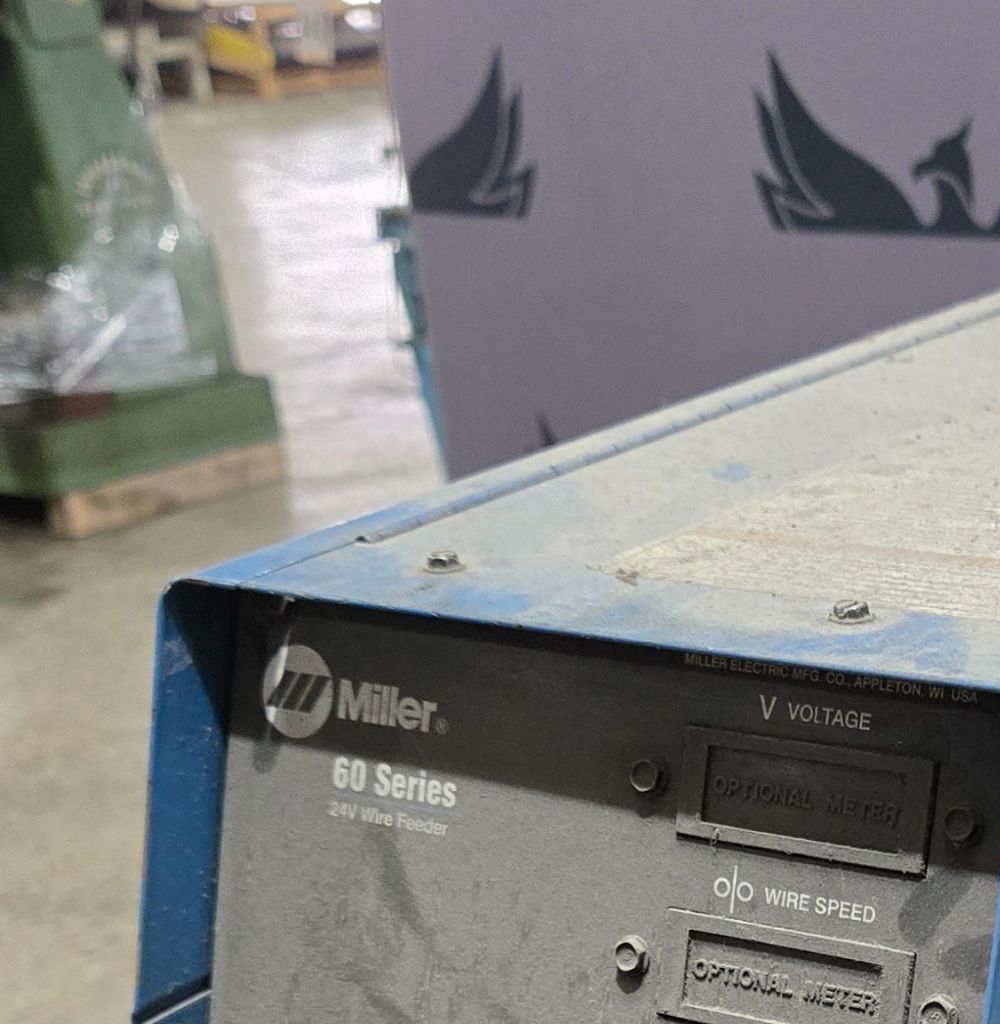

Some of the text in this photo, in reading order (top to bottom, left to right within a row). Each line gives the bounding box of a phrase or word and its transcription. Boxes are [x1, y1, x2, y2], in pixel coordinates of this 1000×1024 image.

[684, 653, 728, 671] MILLER
[729, 660, 790, 679] ELECTRIC
[928, 685, 945, 700] WI
[951, 688, 979, 704] USA
[760, 695, 872, 731] V VOLTAGE
[332, 756, 457, 809] 60 Series
[713, 774, 900, 829] OPTIONAL METER
[328, 800, 449, 838] 24V Wire Feeder
[764, 887, 877, 924] WIRE SPEED
[692, 957, 880, 1016] OPTIONAL METER
